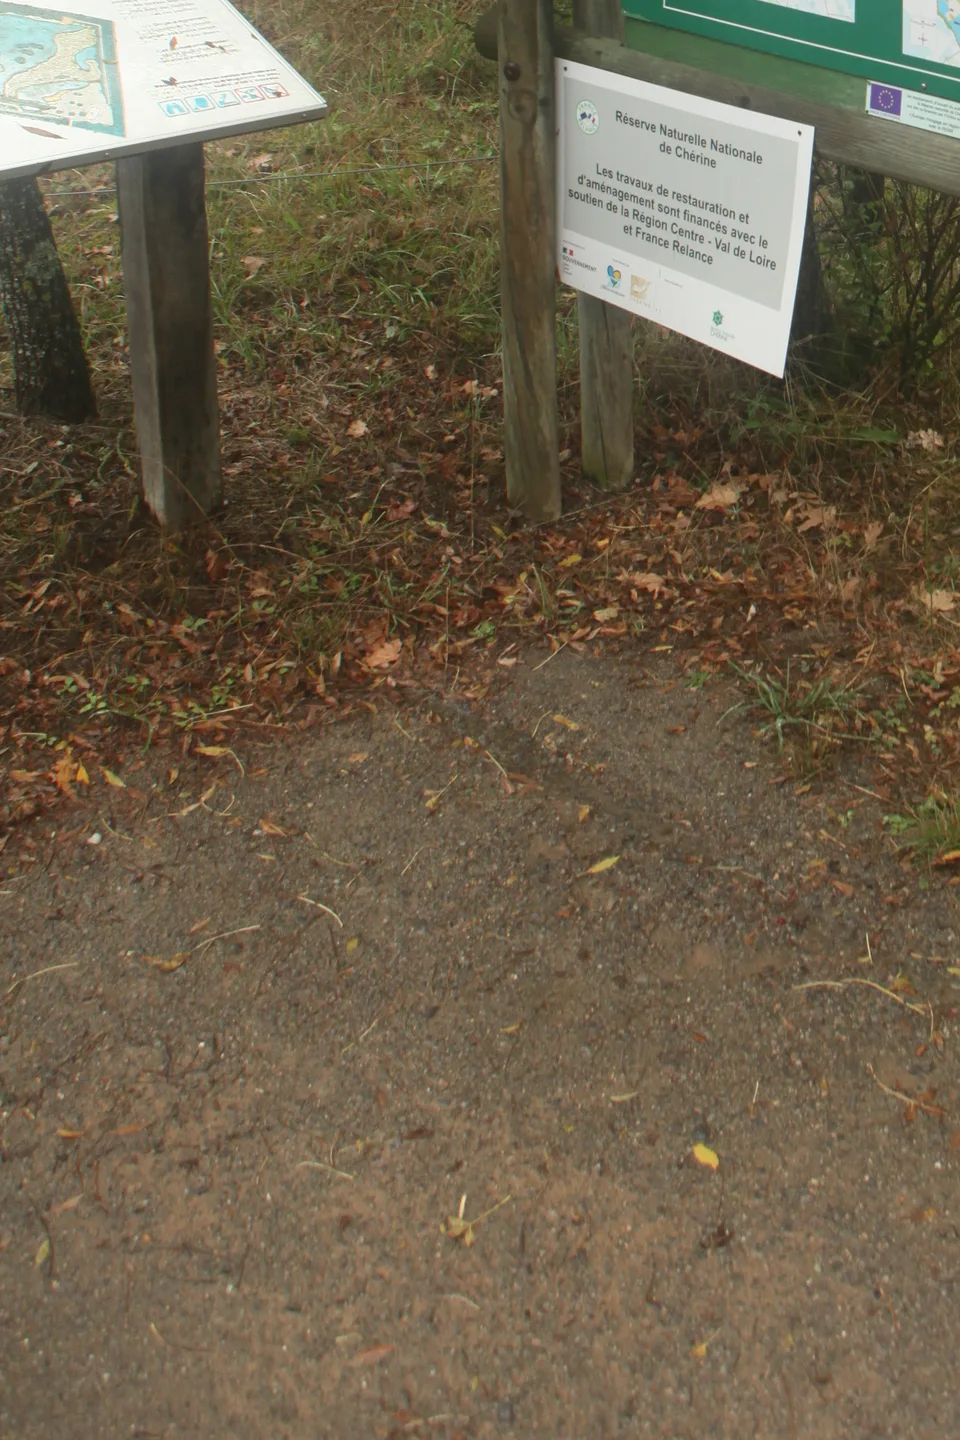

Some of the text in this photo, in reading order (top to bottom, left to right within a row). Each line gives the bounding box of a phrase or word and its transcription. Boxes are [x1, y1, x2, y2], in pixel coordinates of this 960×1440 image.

[615, 110, 656, 133] Réserve
[659, 123, 706, 148] Naturelle
[710, 138, 763, 165] Nationale
[659, 141, 716, 168] de Chérine
[577, 173, 768, 249] d'aménagement sont financés avec le
[596, 163, 750, 224] Les travaux de restauration et
[568, 189, 603, 210] soutien
[605, 199, 617, 215] de
[620, 205, 629, 219] la
[632, 209, 667, 232] Région
[670, 222, 704, 245] Centre
[714, 238, 730, 254] Val
[733, 244, 745, 260] de
[749, 250, 776, 271] Loire
[623, 224, 713, 265] et France Relance
